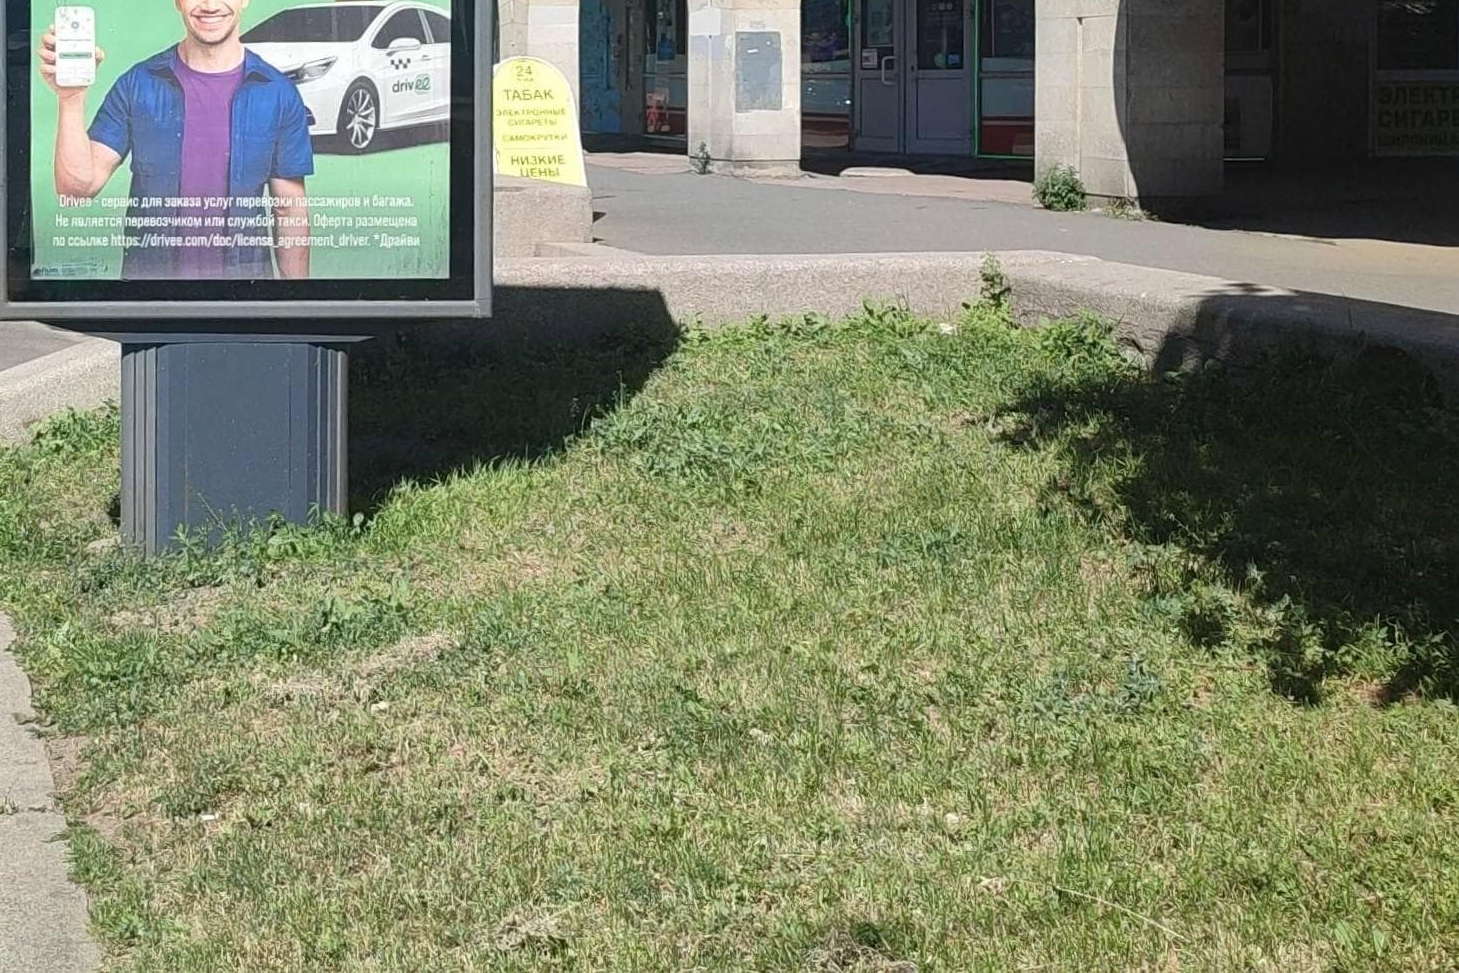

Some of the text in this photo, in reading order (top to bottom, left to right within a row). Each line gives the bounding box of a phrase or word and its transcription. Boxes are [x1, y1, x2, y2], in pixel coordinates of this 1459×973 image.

[391, 73, 432, 95] drivee
[503, 89, 555, 102] ТАБАК
[510, 154, 566, 166] НИЗКИЕ
[520, 167, 560, 178] ЦЕНЫ
[59, 194, 92, 207] Drivee
[101, 197, 139, 209] сервис
[141, 197, 163, 209] для
[164, 196, 202, 207] заказа
[203, 196, 233, 210] услуг
[236, 196, 292, 210] перевозки
[295, 196, 361, 210] пассажиров
[55, 214, 69, 227] Не
[71, 216, 123, 227] является
[125, 216, 203, 229] перевозчиком
[204, 216, 225, 227] или
[228, 213, 275, 230] службой
[313, 214, 353, 229] Оферта
[355, 216, 418, 230] размещена
[52, 235, 66, 246] по
[68, 235, 109, 247] ссылке
